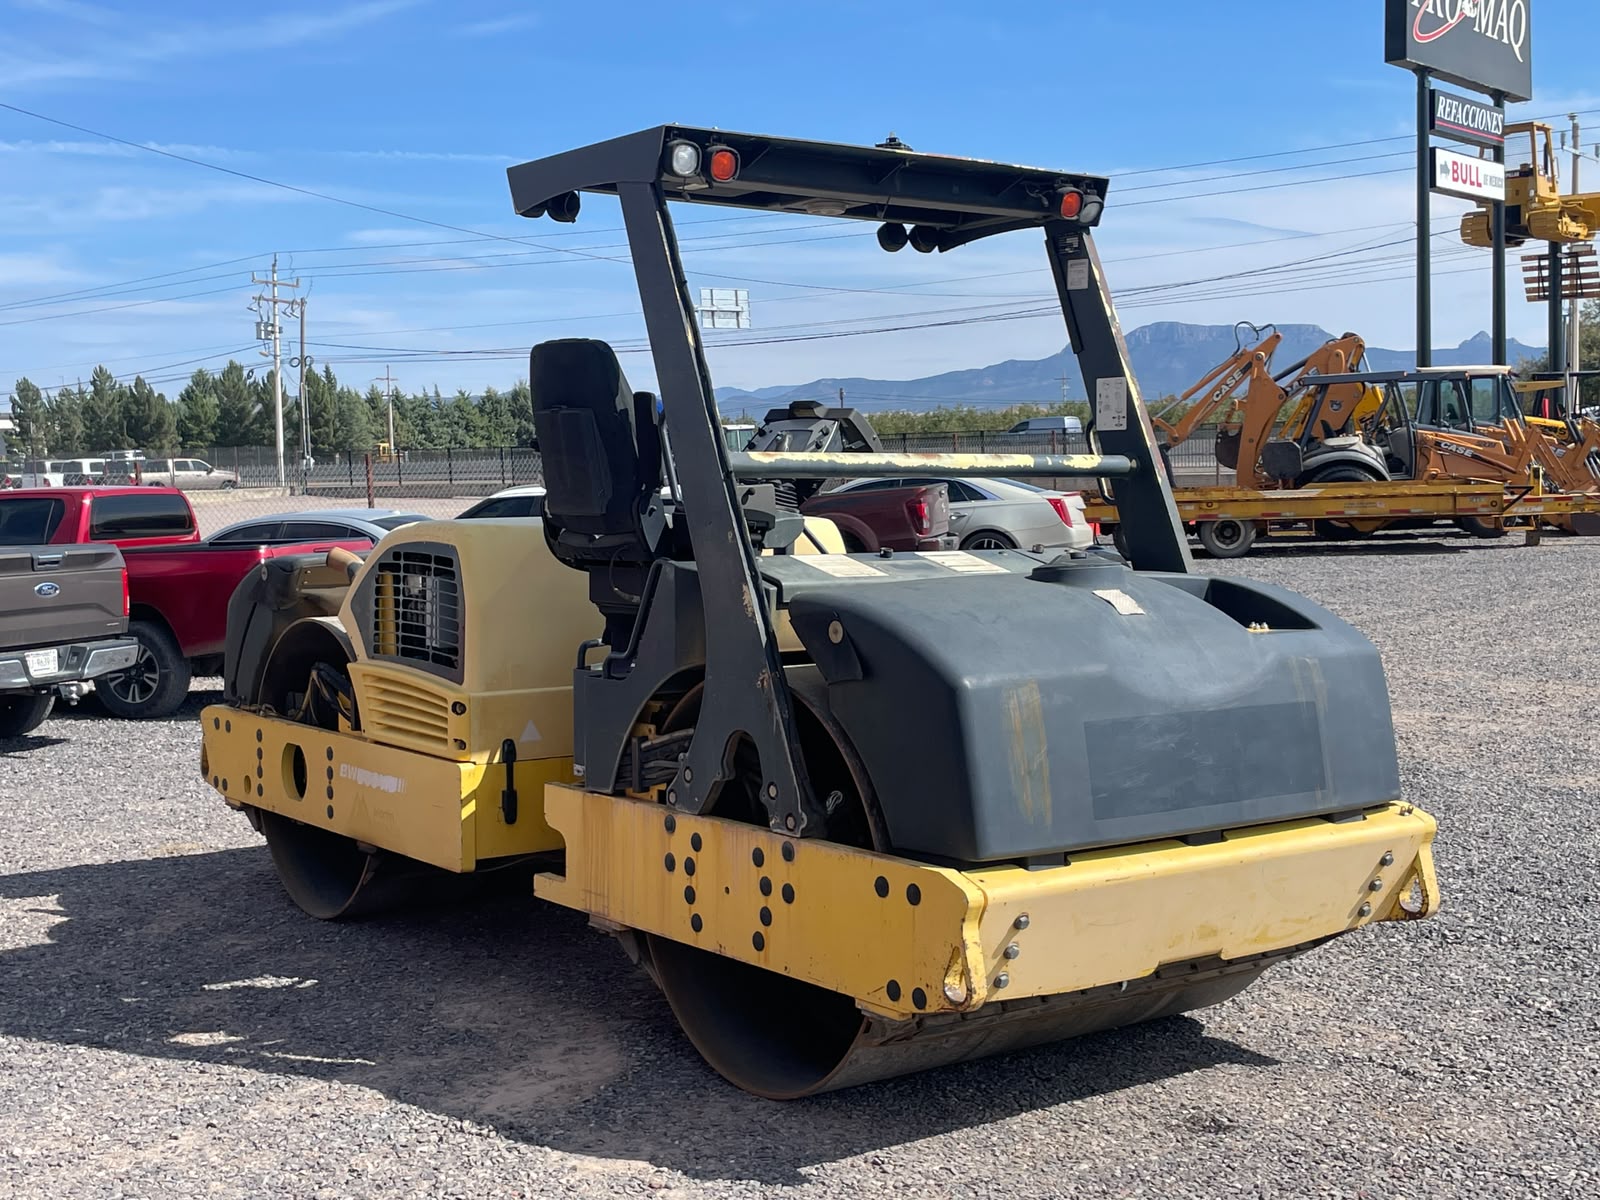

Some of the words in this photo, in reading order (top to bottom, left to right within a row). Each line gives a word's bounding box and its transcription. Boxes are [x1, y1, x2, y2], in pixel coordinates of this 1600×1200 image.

[1437, 96, 1503, 135] REFACCIONES
[1452, 160, 1482, 188] BULL
[1213, 368, 1243, 402] CASE
[1440, 441, 1474, 457] CASE
